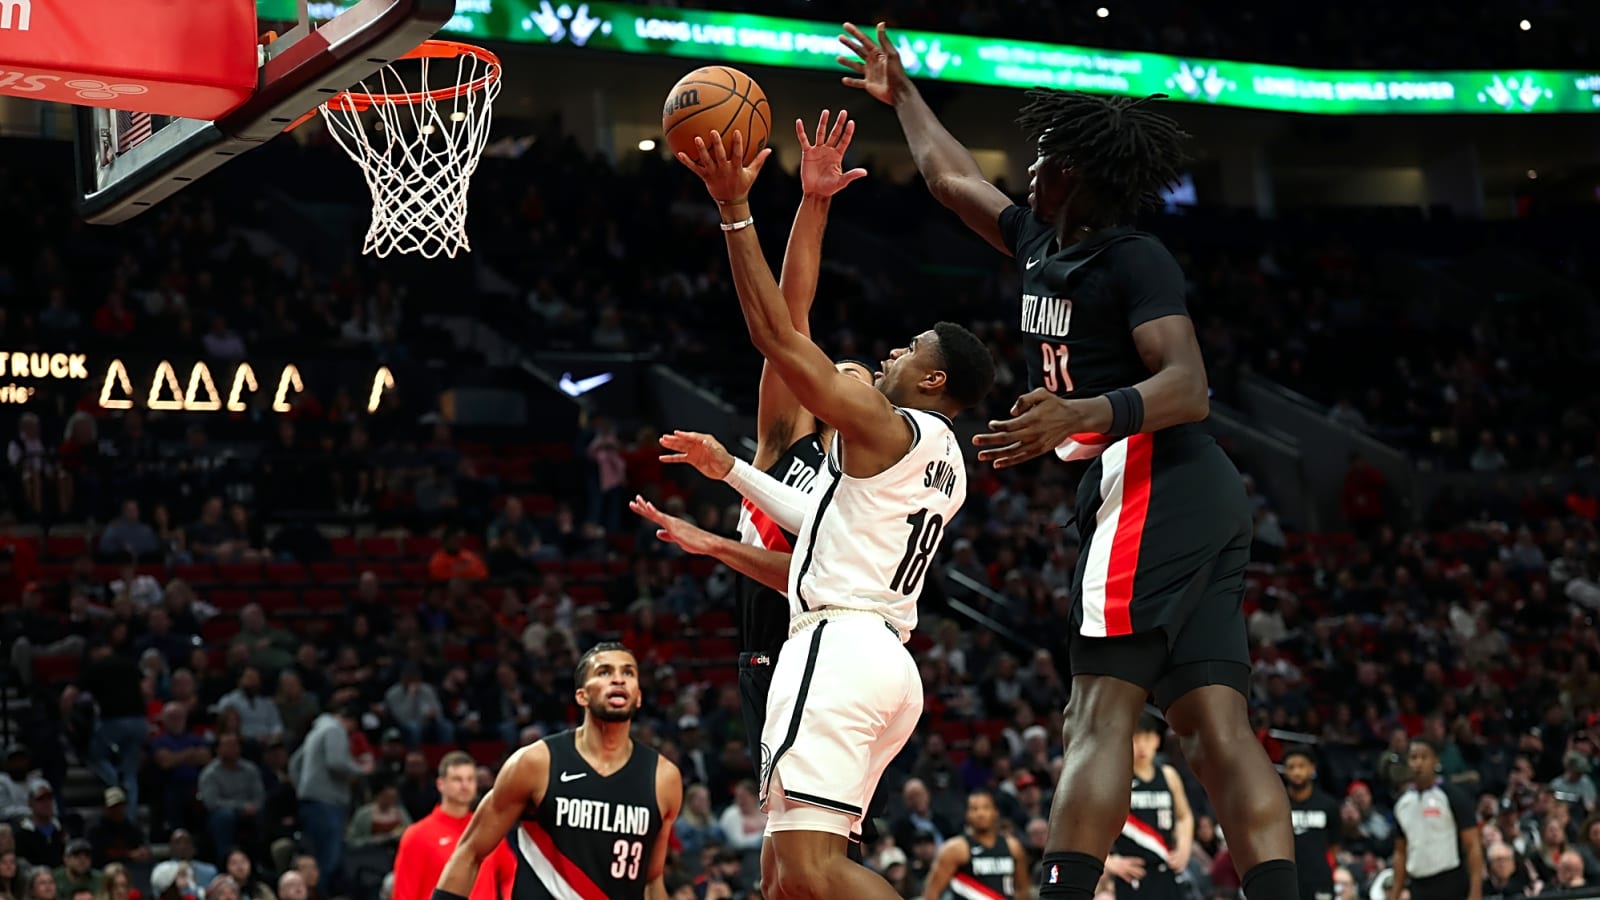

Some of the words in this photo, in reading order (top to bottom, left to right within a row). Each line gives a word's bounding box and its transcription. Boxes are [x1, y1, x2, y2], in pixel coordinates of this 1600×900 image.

[635, 18, 691, 40] LONG
[692, 25, 736, 45] LIVE
[1388, 81, 1454, 100] POWER
[0, 352, 88, 379] TRUCK
[1041, 342, 1074, 392] 91
[924, 460, 956, 499] SMITH
[889, 507, 943, 596] 18
[556, 797, 649, 836] PORTLAND
[611, 840, 643, 880] 33
